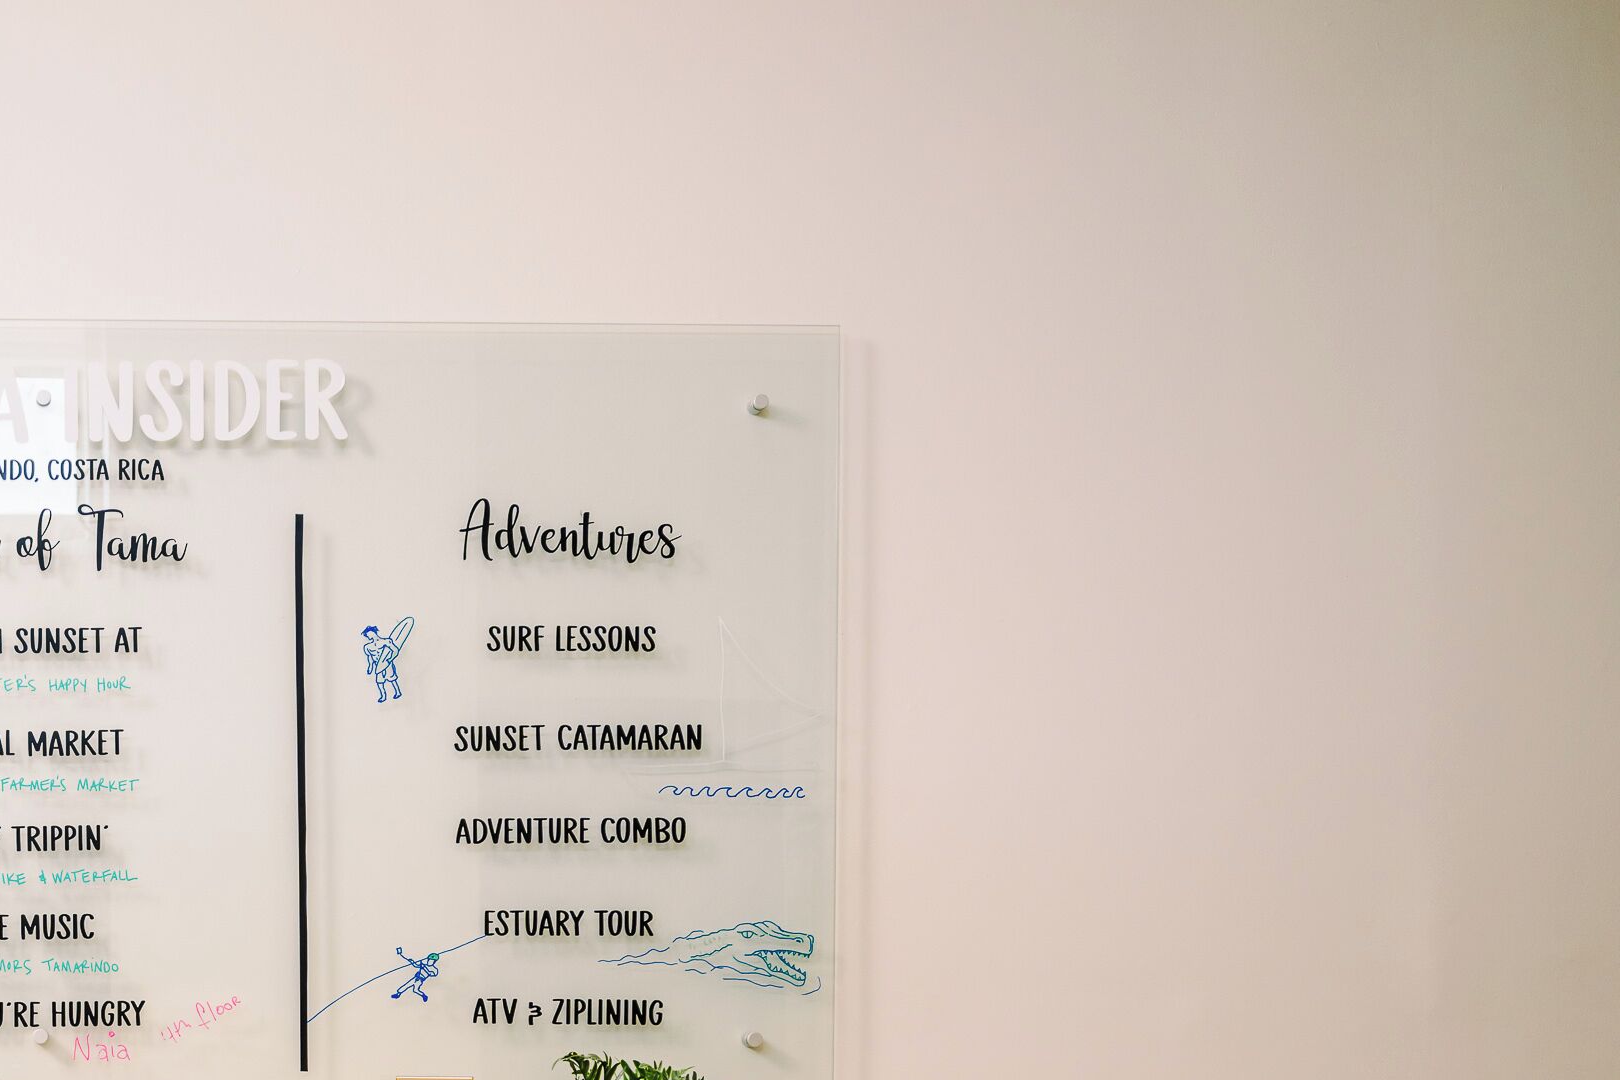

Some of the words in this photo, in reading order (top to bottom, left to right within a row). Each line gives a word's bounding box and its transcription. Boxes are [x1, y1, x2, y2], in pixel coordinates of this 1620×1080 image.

[64, 358, 349, 443] INSIDER
[47, 458, 110, 481] COSTA
[118, 458, 165, 481] RICA
[16, 508, 61, 572] of
[77, 503, 188, 572] Tama
[459, 497, 682, 564] Adventures
[13, 627, 105, 654] SUNSET
[114, 626, 143, 653] AT
[486, 625, 545, 652] SURF
[555, 625, 657, 653] LESSONS
[48, 678, 88, 693] HAPPY
[27, 729, 124, 757] MARKET
[453, 724, 546, 752] SUNSET
[557, 723, 702, 751] CATAMARAN
[0, 777, 67, 793] FARMER'S
[77, 778, 139, 793] MARKET
[10, 824, 109, 852] TRIPPIN'
[455, 817, 591, 845] ADVENTURE
[600, 816, 687, 844] COMBO
[51, 869, 138, 884] WATERFALL
[20, 913, 95, 941] MUSIC
[481, 909, 585, 939] ESTUARY
[593, 909, 654, 937] TOUR
[51, 1000, 146, 1028] HUNGRY
[472, 997, 518, 1025] ATV
[551, 998, 664, 1026] ZIPLINING
[72, 1031, 130, 1062] Naia
